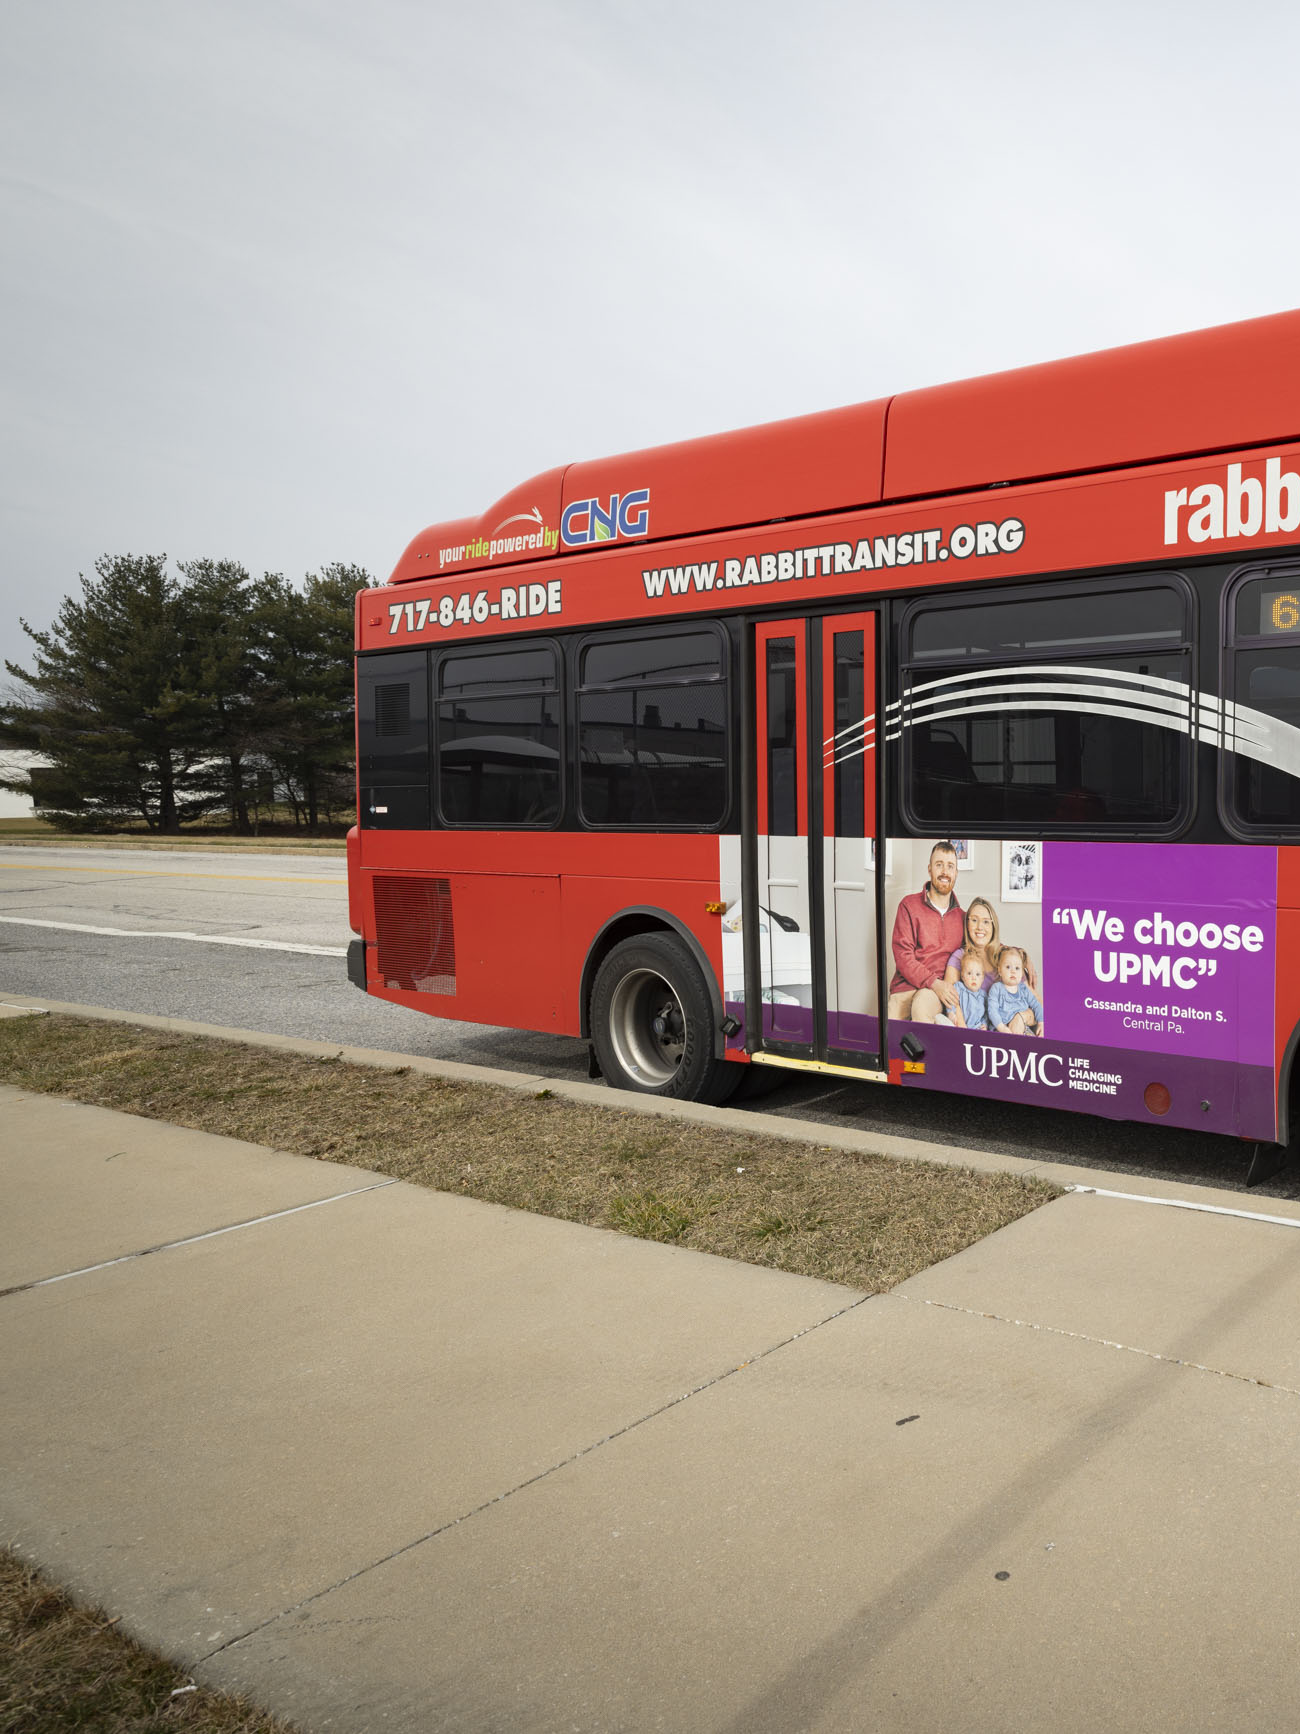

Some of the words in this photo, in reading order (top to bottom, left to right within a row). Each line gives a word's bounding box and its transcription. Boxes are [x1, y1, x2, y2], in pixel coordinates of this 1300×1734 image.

[561, 488, 650, 547] CNG
[642, 517, 1025, 600] WWW.RABBITTRANSIT.ORG
[388, 579, 562, 636] 717-846-RIDE
[1053, 907, 1125, 943] “We
[1133, 911, 1265, 953] choose
[1093, 950, 1218, 990] UPMC”
[1084, 997, 1143, 1014] Cassandra
[1145, 1004, 1168, 1016] and
[1171, 1006, 1212, 1021] Dalton
[1215, 1010, 1228, 1022] S.
[1122, 1016, 1164, 1032] Central
[1167, 1021, 1186, 1034] Pa.
[963, 1043, 1064, 1087] UPMC
[1068, 1057, 1090, 1069] LIFE
[1068, 1068, 1123, 1084] CHANGING
[1068, 1079, 1118, 1095] MEDICINE
